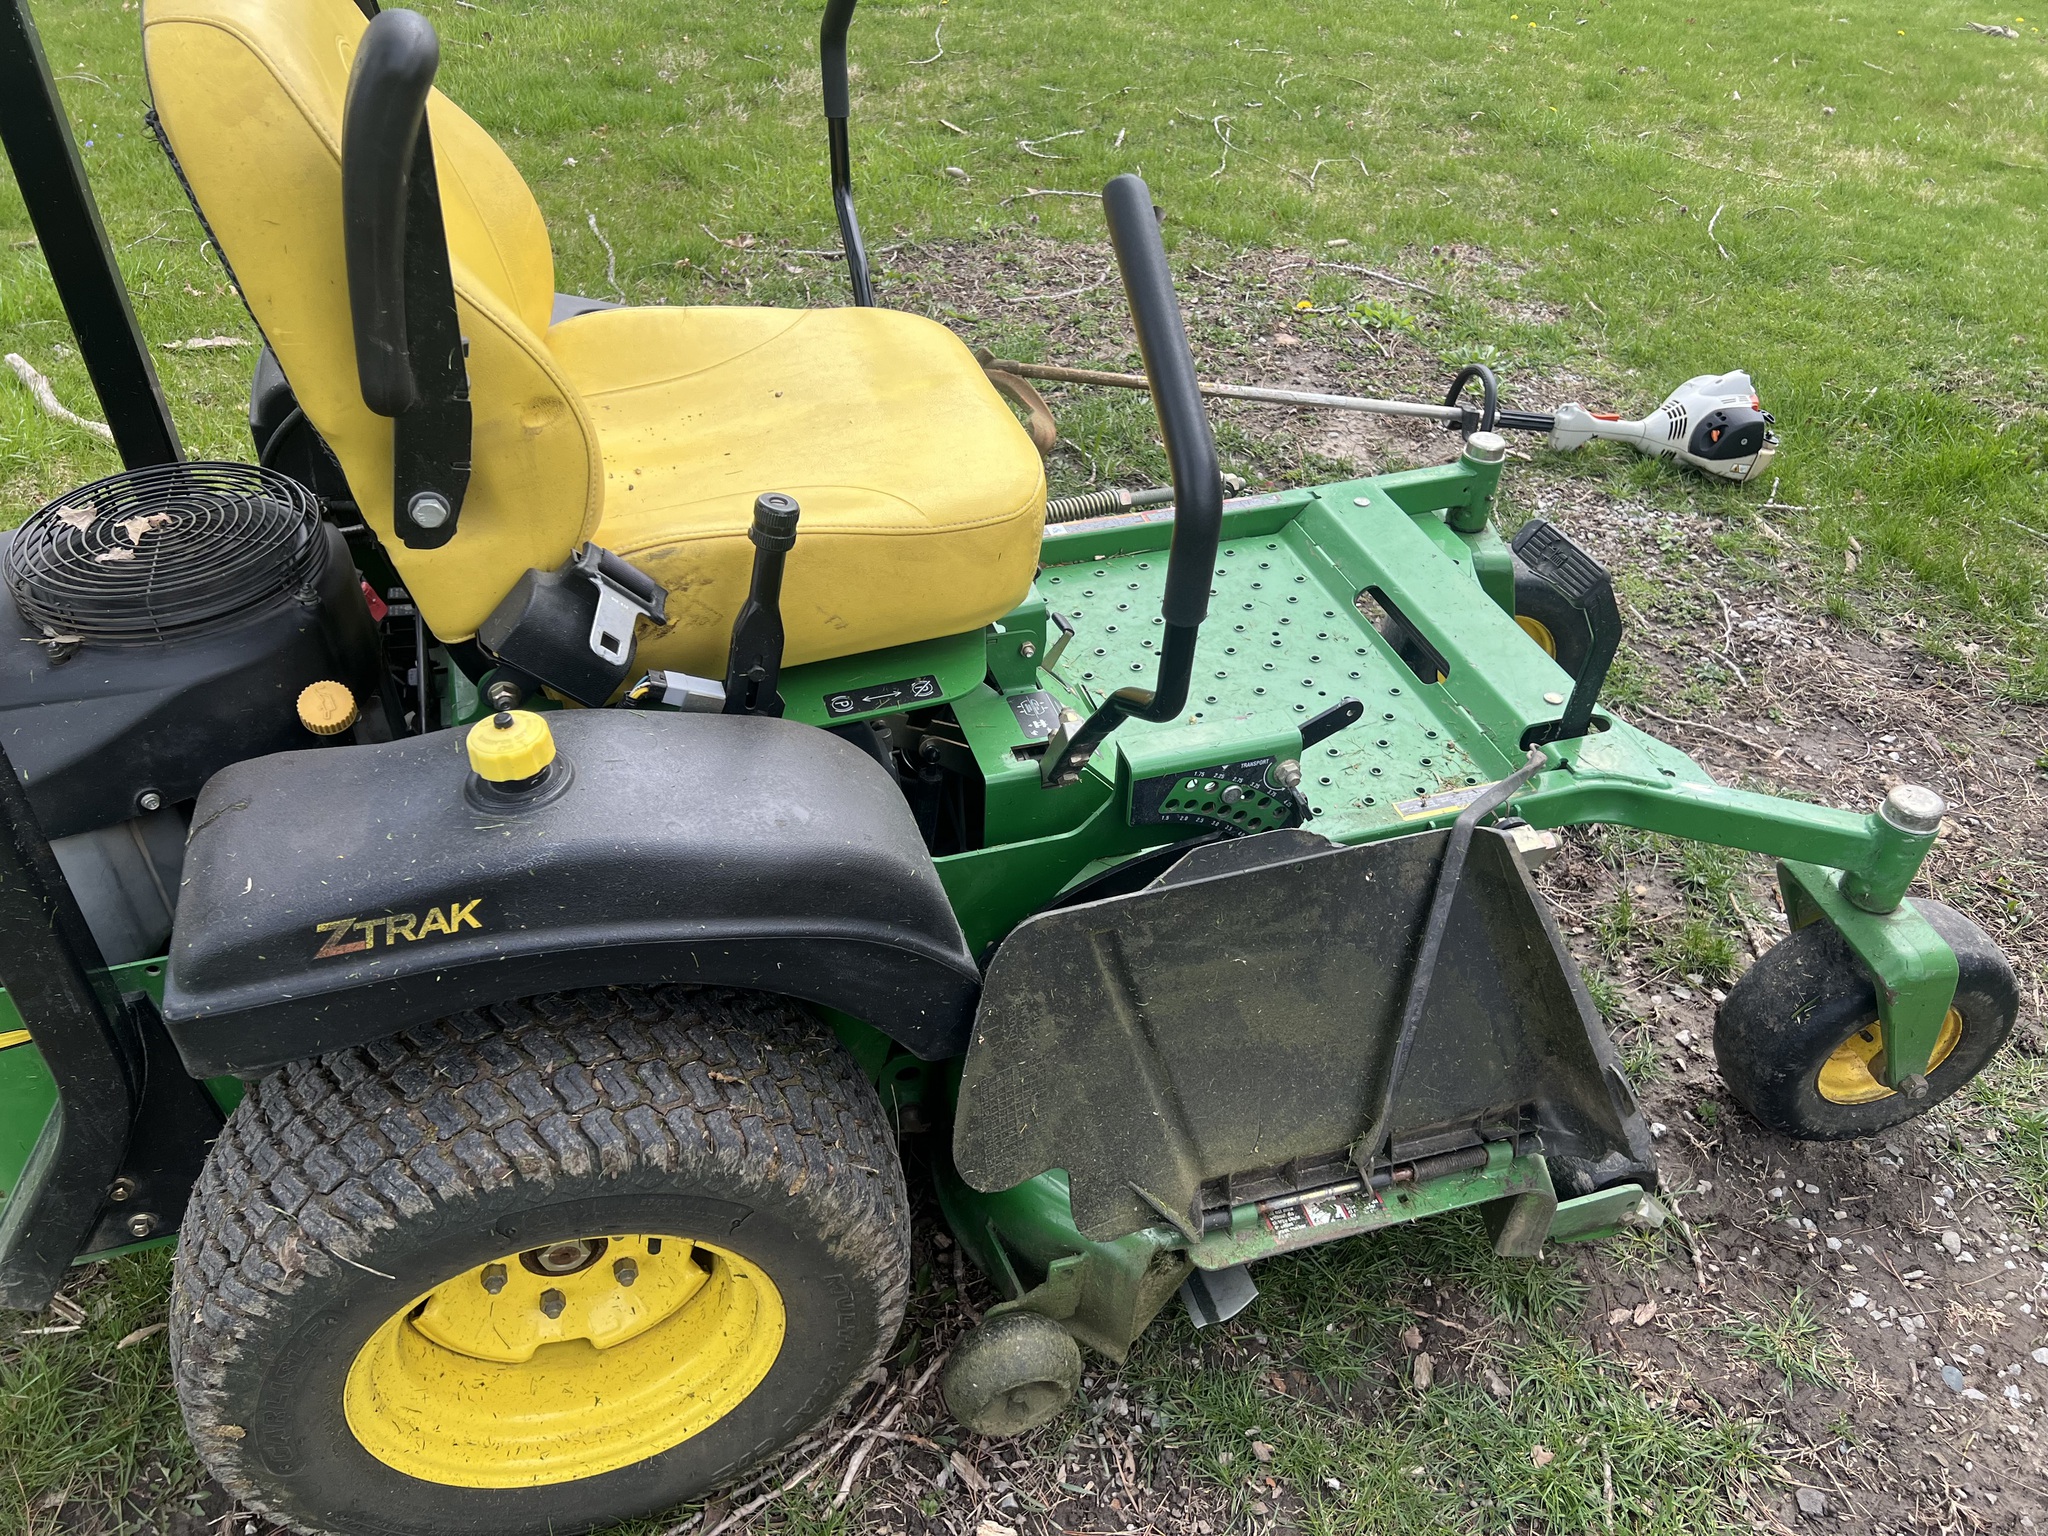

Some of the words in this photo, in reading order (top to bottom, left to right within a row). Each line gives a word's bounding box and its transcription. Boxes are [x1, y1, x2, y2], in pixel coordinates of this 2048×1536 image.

[1213, 772, 1225, 780] 2.25
[1232, 776, 1244, 784] 2.75
[1250, 781, 1261, 790] 3.25
[1267, 789, 1277, 798] 3.75
[1240, 758, 1270, 769] TRANSPORT
[313, 898, 483, 960] ZTRAK
[263, 1322, 329, 1462] CARLISLE
